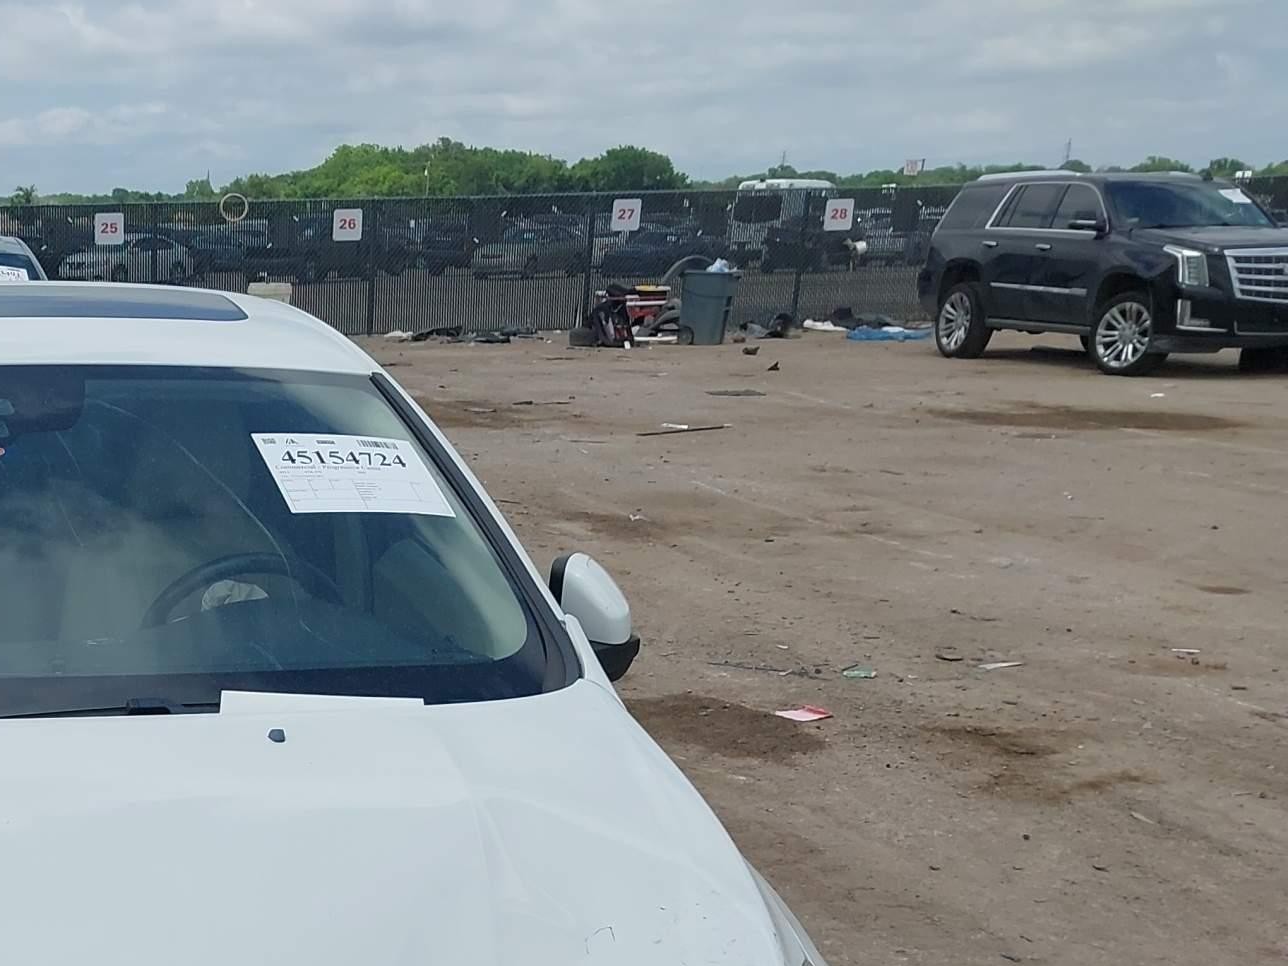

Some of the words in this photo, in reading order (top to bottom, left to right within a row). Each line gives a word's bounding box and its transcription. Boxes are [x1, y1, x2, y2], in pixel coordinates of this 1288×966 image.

[617, 208, 635, 220] 27
[830, 208, 847, 220] 28
[100, 222, 118, 234] 25
[338, 218, 357, 230] 26
[281, 450, 407, 468] 45154724
